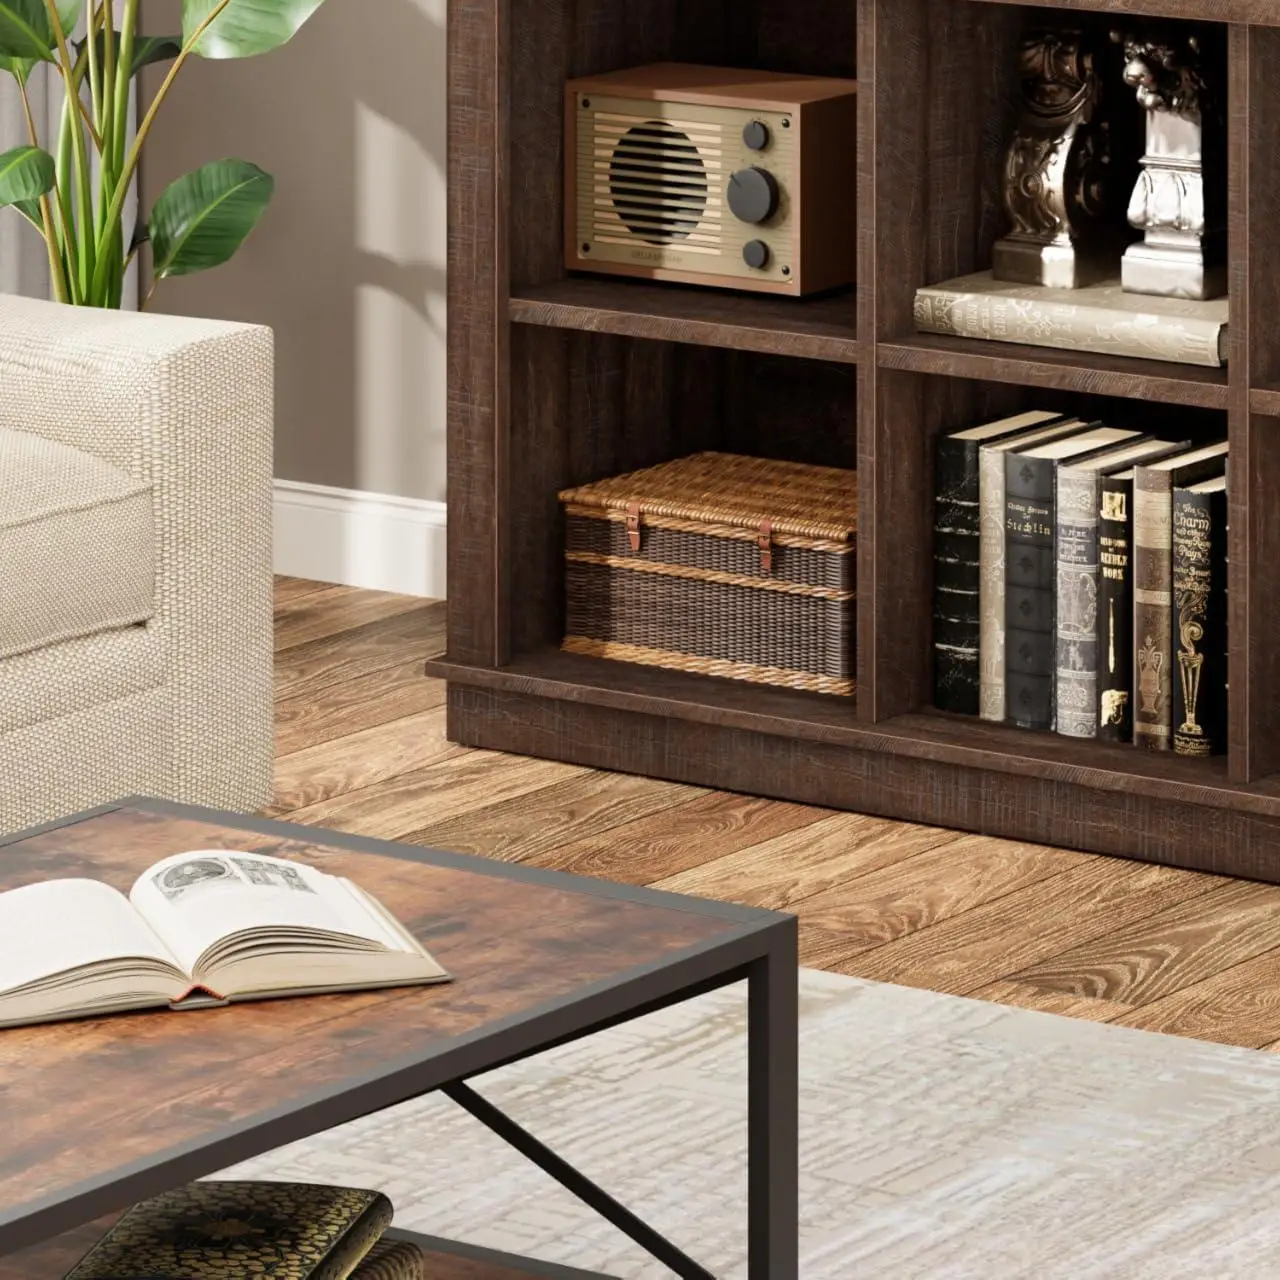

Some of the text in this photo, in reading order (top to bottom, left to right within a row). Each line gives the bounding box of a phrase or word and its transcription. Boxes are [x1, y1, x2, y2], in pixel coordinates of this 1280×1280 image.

[1174, 510, 1209, 531] Charm
[1178, 545, 1202, 560] Plays
[1102, 567, 1124, 580] WORK
